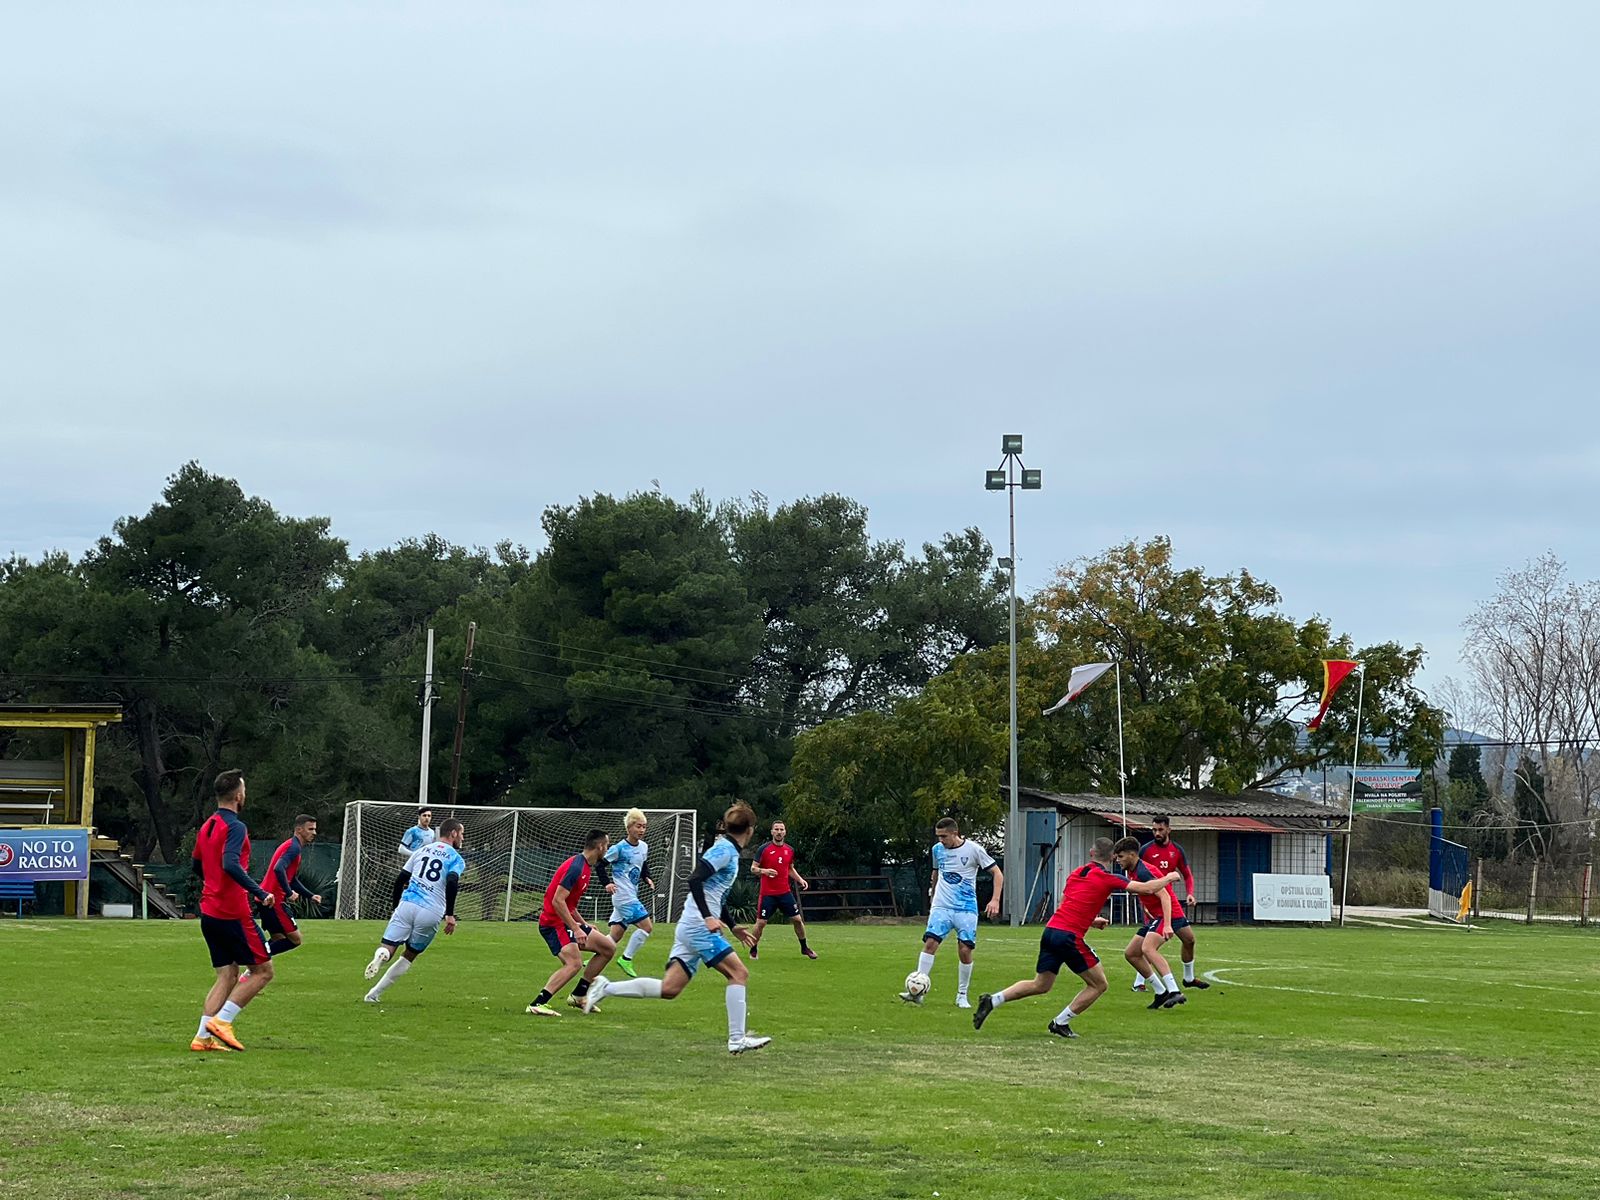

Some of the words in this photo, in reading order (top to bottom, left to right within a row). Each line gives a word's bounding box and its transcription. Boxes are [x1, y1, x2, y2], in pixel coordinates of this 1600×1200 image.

[22, 840, 47, 854] NO
[52, 840, 74, 853] TO
[432, 849, 451, 860] ZORA
[19, 855, 77, 869] RACISM
[778, 856, 783, 864] 2
[1160, 860, 1169, 868] 33
[418, 856, 443, 882] 18
[1277, 899, 1301, 908] KOMUNA
[1302, 900, 1306, 908] E
[761, 909, 766, 917] 2
